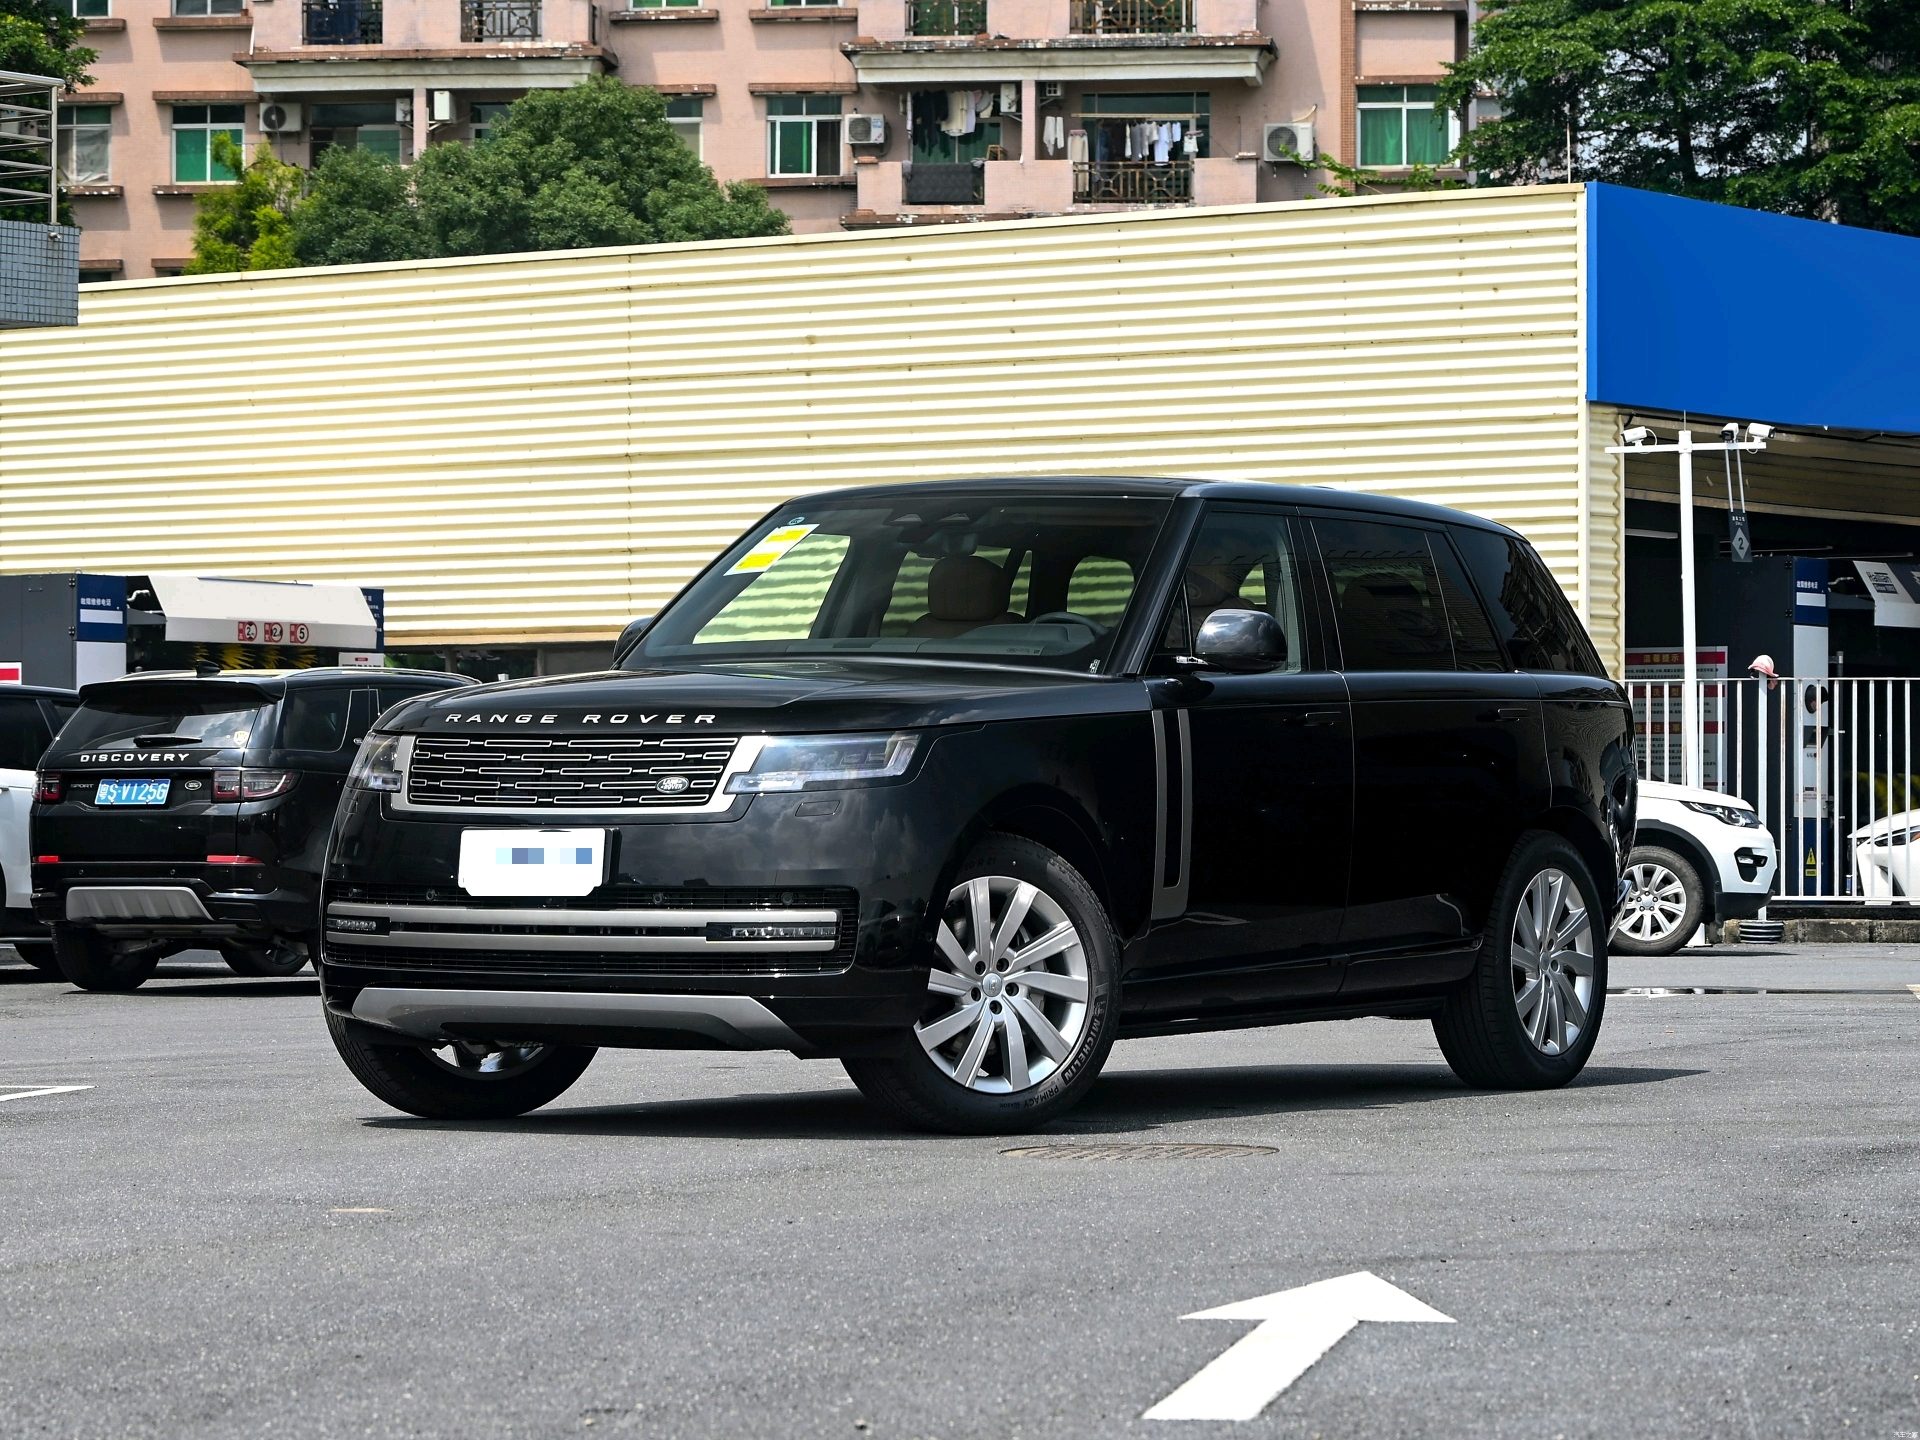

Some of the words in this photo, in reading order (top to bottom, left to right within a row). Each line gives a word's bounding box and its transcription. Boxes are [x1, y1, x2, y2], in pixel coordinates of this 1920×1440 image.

[1738, 537, 1744, 550] 2
[445, 713, 560, 724] RANGE
[582, 713, 717, 724] ROVER
[80, 753, 190, 763] DISCOVERY
[1064, 1018, 1101, 1081] MICHELIN
[1024, 1085, 1060, 1108] PRIMACY
